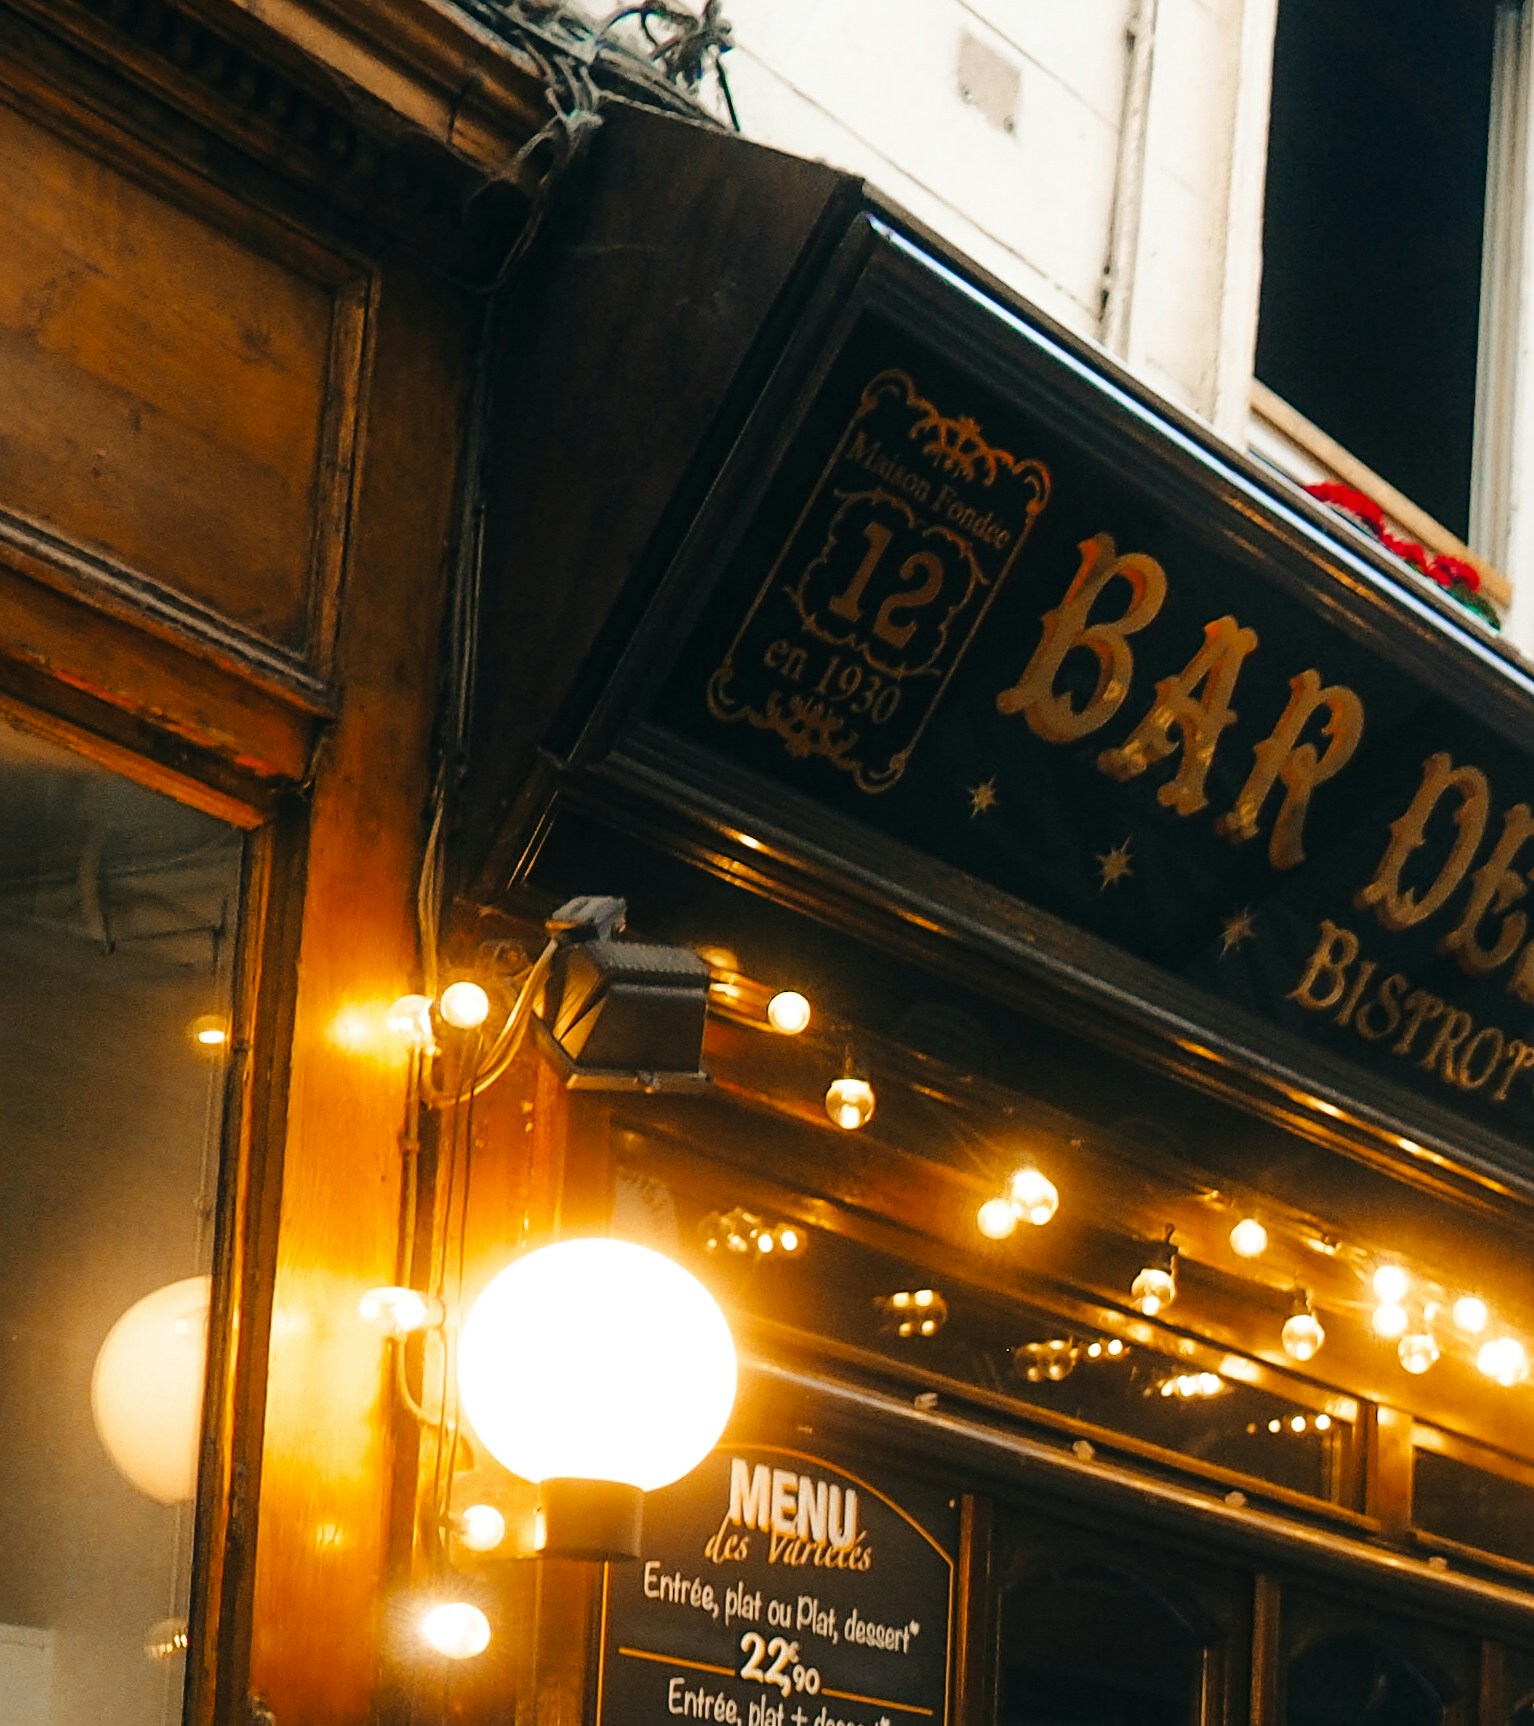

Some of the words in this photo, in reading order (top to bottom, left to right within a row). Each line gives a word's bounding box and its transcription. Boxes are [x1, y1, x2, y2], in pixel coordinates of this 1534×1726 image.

[828, 521, 946, 650] 12
[763, 636, 804, 682] en
[812, 652, 902, 726] 1930
[997, 531, 1366, 871] BAR
[705, 1512, 749, 1565] des
[728, 1457, 858, 1549] MENU
[643, 1561, 719, 1618] Entrée,
[725, 1581, 760, 1627] plat
[767, 1598, 791, 1629] ou
[797, 1595, 839, 1645] Plat,
